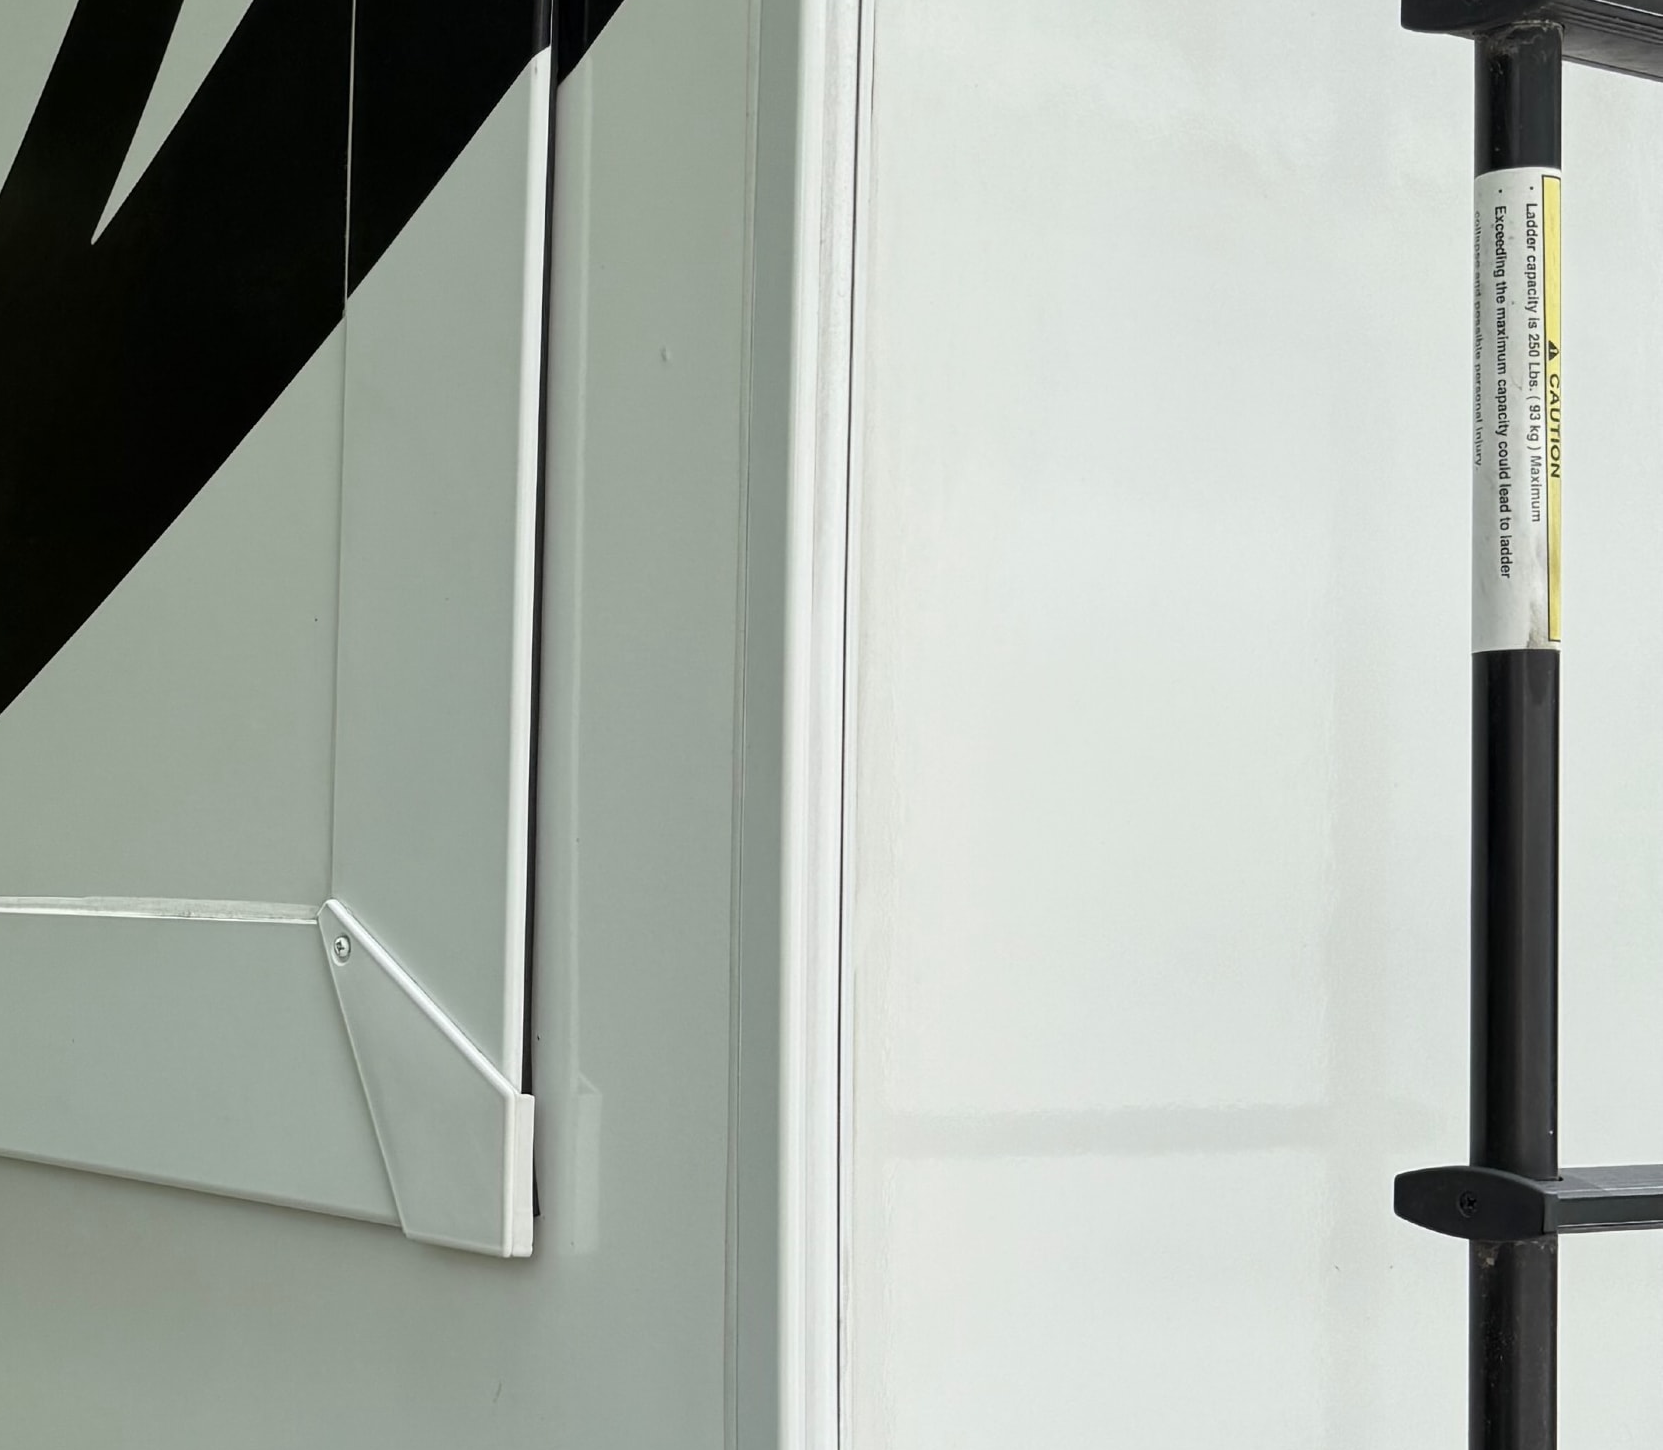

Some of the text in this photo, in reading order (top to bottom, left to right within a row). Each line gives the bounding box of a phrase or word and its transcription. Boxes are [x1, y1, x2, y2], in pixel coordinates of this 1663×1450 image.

[1525, 203, 1538, 252] Ladder
[1524, 255, 1539, 313] capacity
[1528, 318, 1540, 329] is
[1528, 334, 1540, 357] 250
[1493, 206, 1514, 579] Exceeding the maximum capacity could lead to ladder
[1529, 363, 1541, 392] Lbs.
[1529, 405, 1541, 421] 93
[1550, 374, 1560, 478] CAUTION
[1526, 425, 1541, 442] kg
[1530, 455, 1543, 522] Maximum
